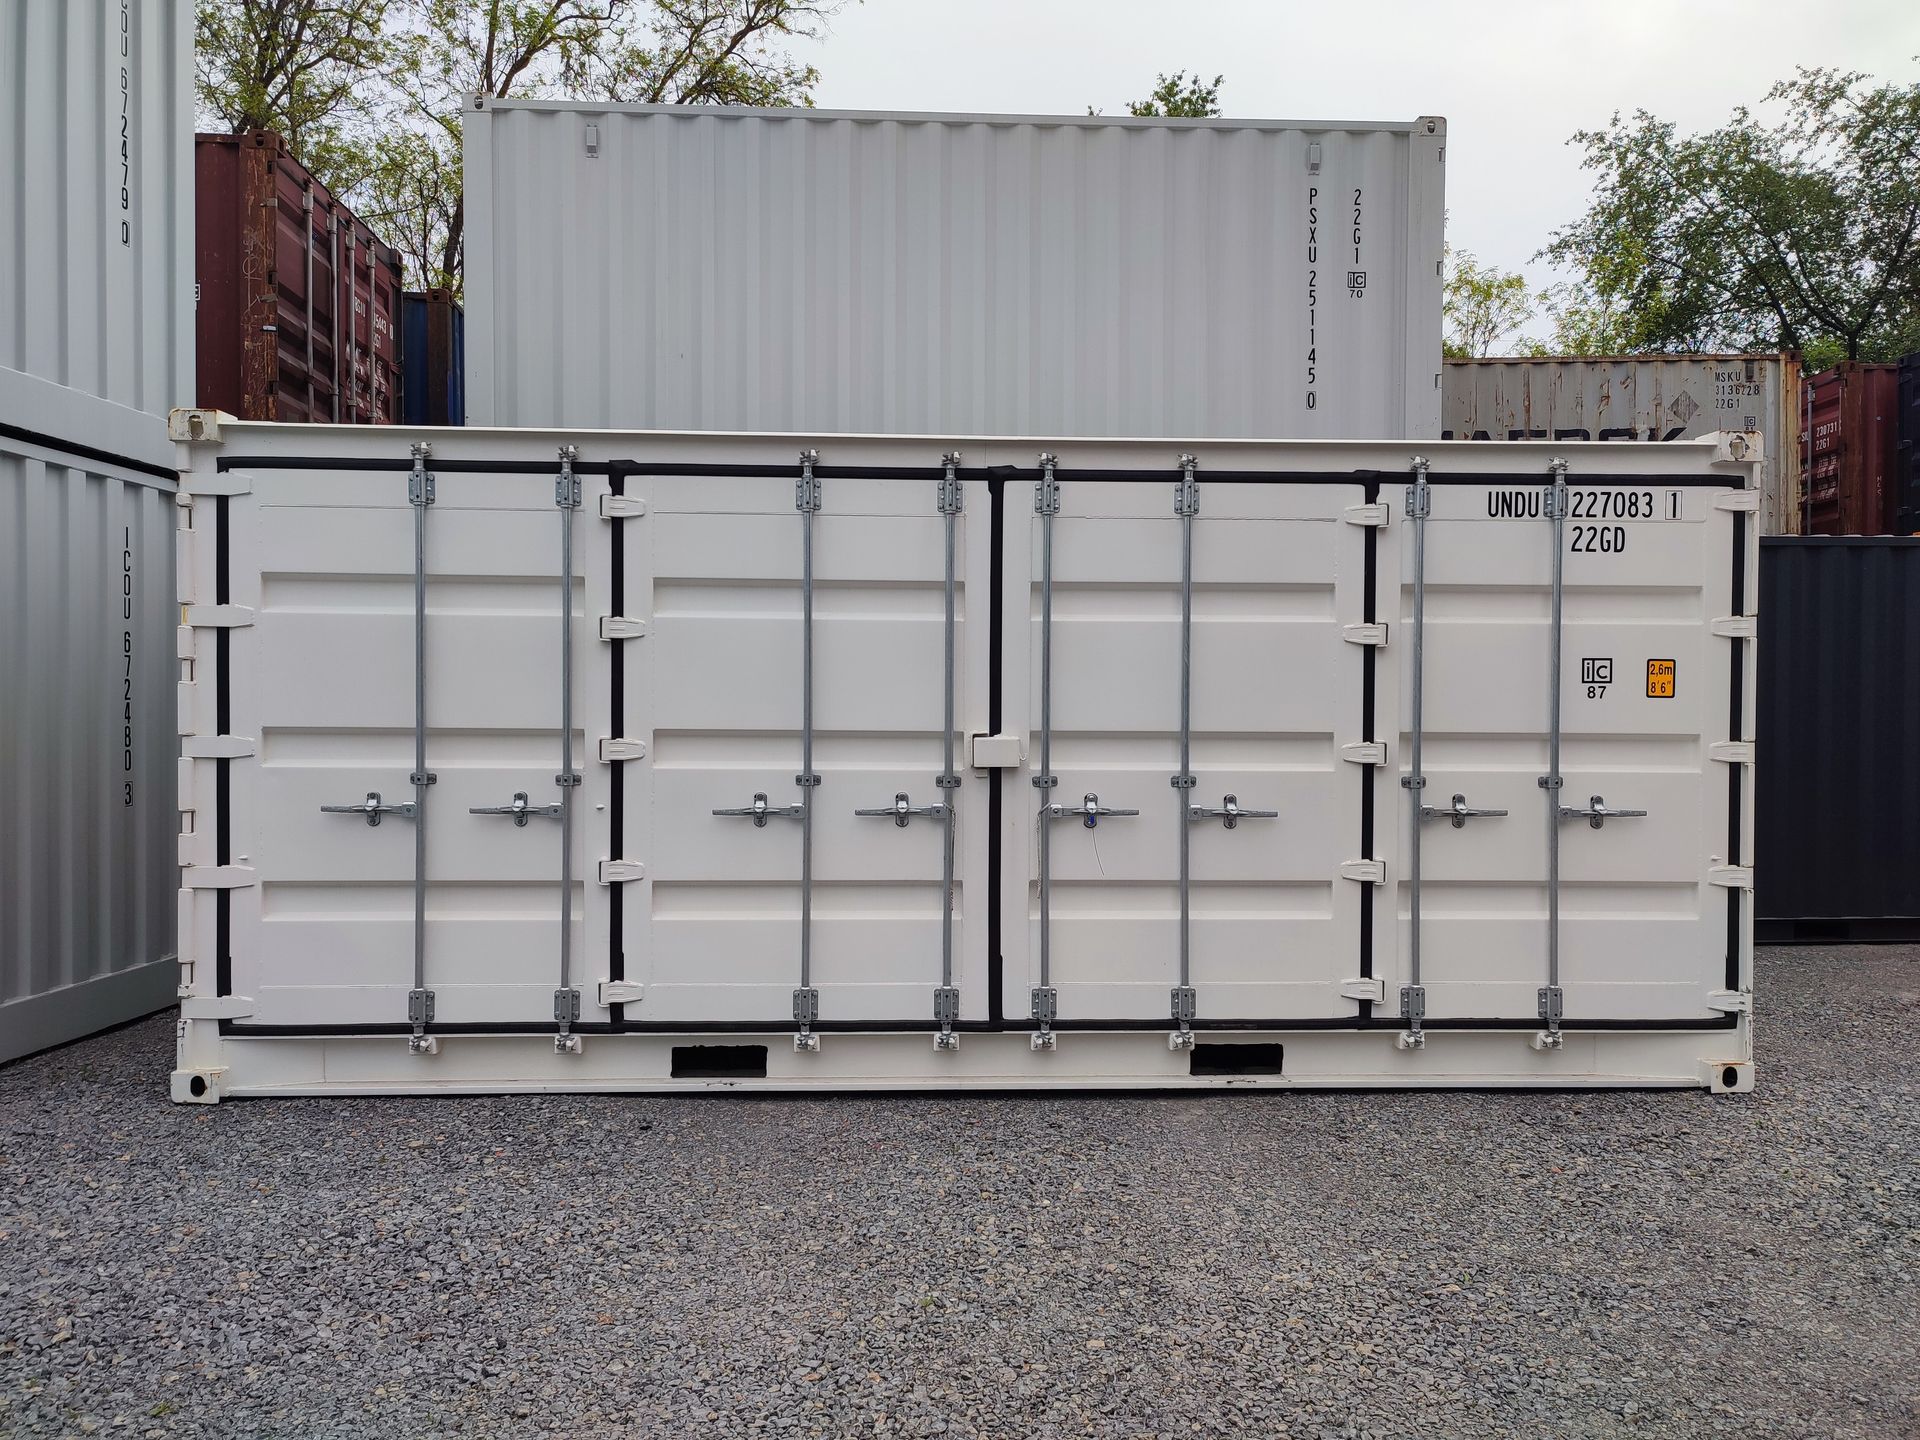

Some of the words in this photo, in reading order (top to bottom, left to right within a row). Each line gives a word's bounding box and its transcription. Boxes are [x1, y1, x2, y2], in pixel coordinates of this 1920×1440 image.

[121, 221, 129, 245] 0
[1308, 187, 1318, 263] PSXU
[1353, 188, 1362, 264] 22G1
[1350, 289, 1363, 298] 70
[1307, 270, 1317, 384] 251145
[1715, 371, 1741, 383] MSKU
[1307, 392, 1315, 409] 0
[1715, 384, 1760, 396] 3136228
[1715, 398, 1740, 409] 22G1
[1488, 491, 1540, 518] UNDU
[1571, 491, 1653, 518] 227083
[1571, 526, 1626, 553] 22GD
[123, 526, 131, 619] ICOU
[1650, 663, 1673, 677] 2,6m
[1587, 686, 1607, 699] 87
[124, 783, 132, 806] 3
